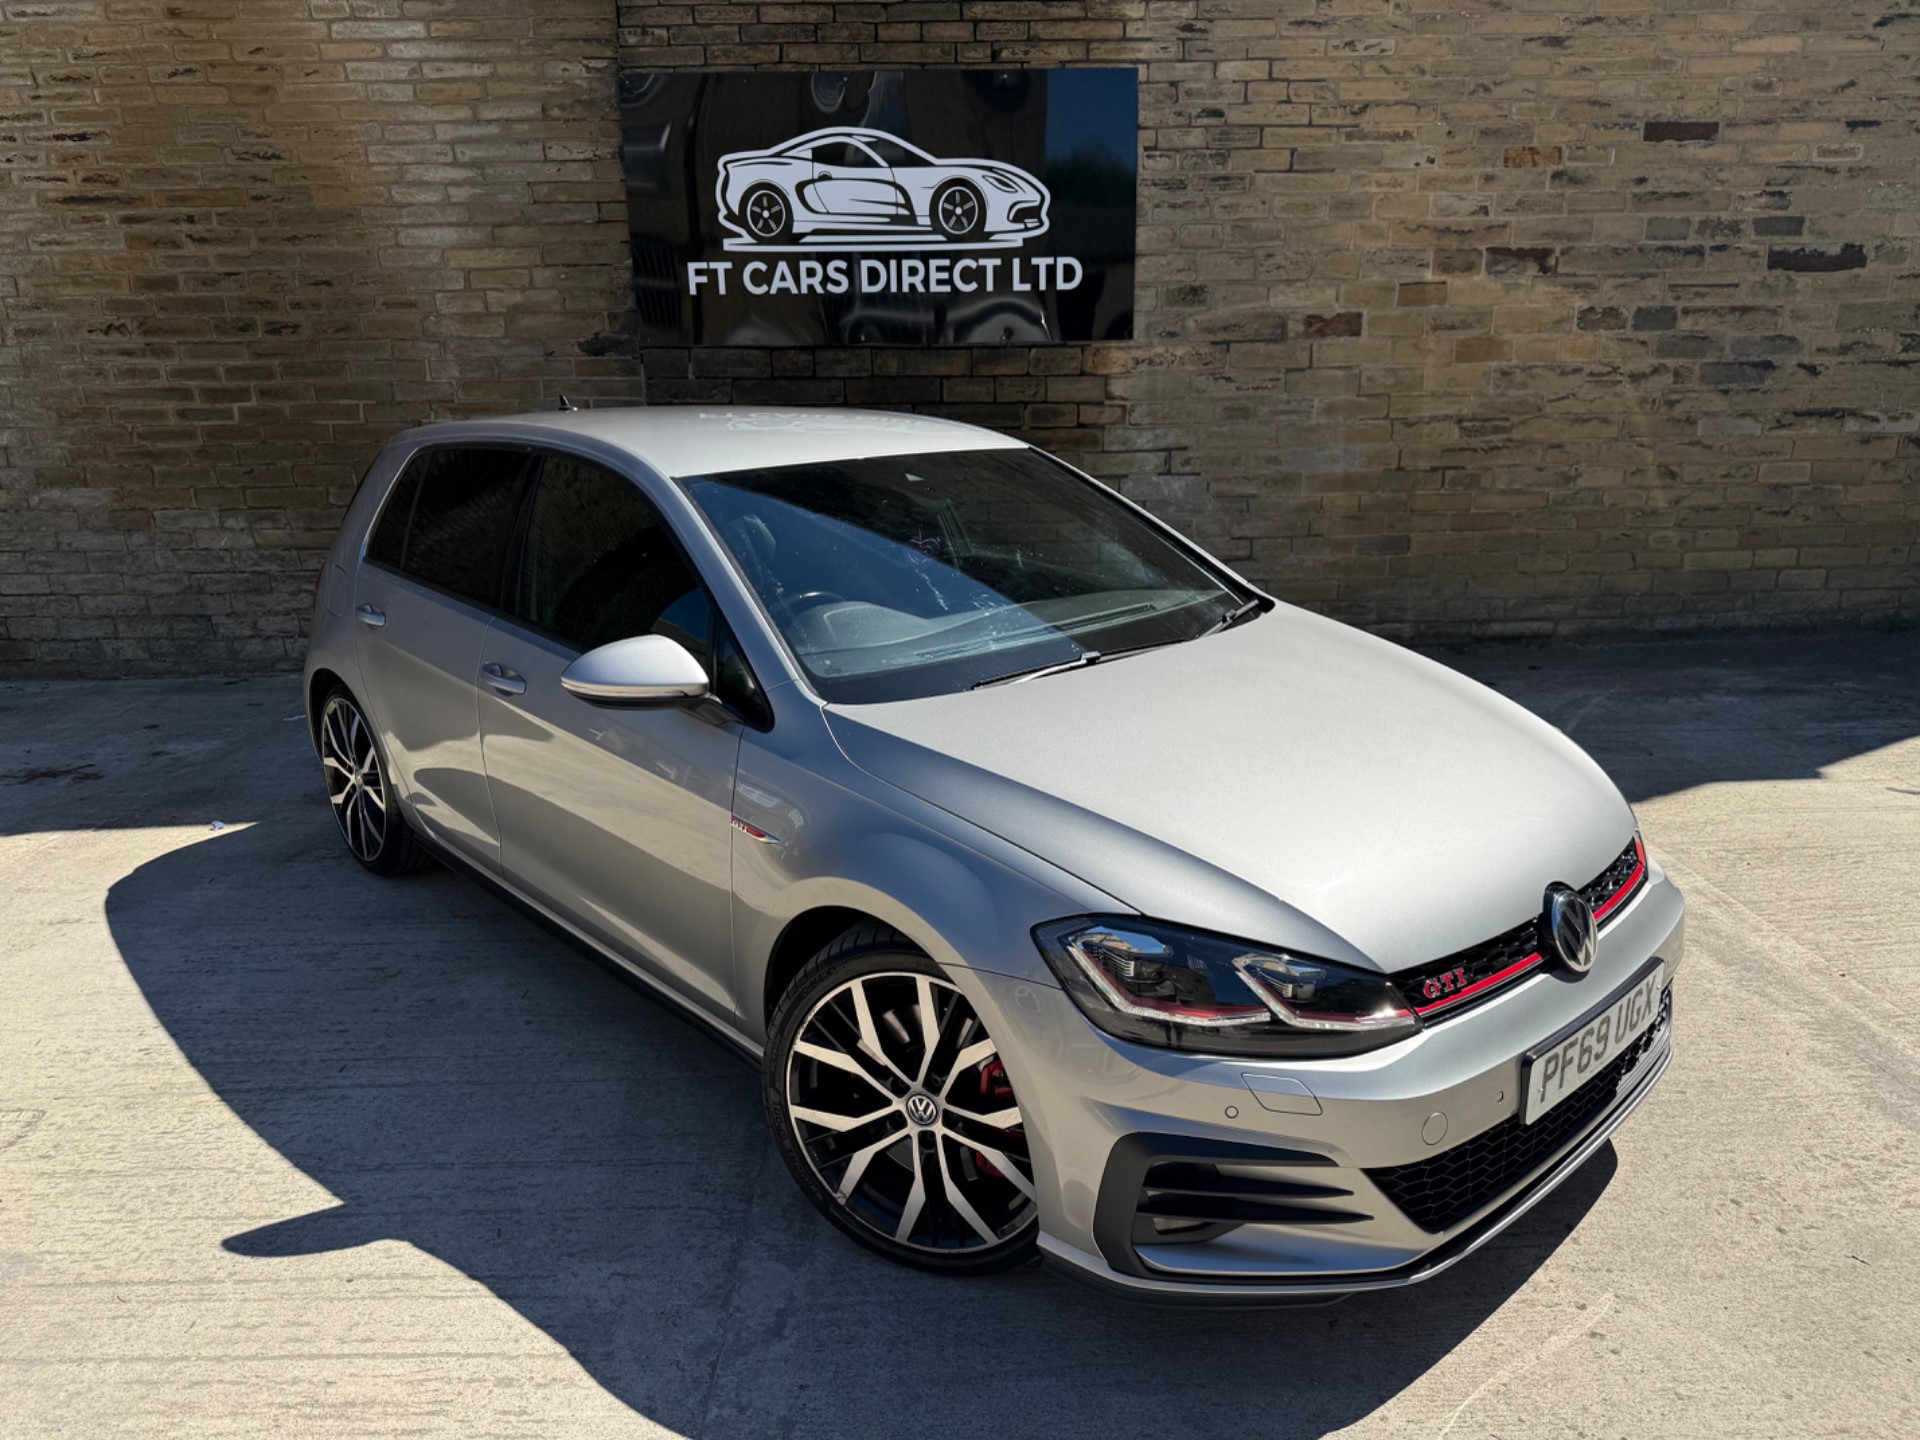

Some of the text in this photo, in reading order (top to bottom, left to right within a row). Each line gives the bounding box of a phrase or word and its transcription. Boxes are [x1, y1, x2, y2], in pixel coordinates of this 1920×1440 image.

[687, 257, 1083, 295] FT CARS DIRECT LTD
[1423, 968, 1467, 999] GTI
[1540, 975, 1656, 1103] PF69 UGX
